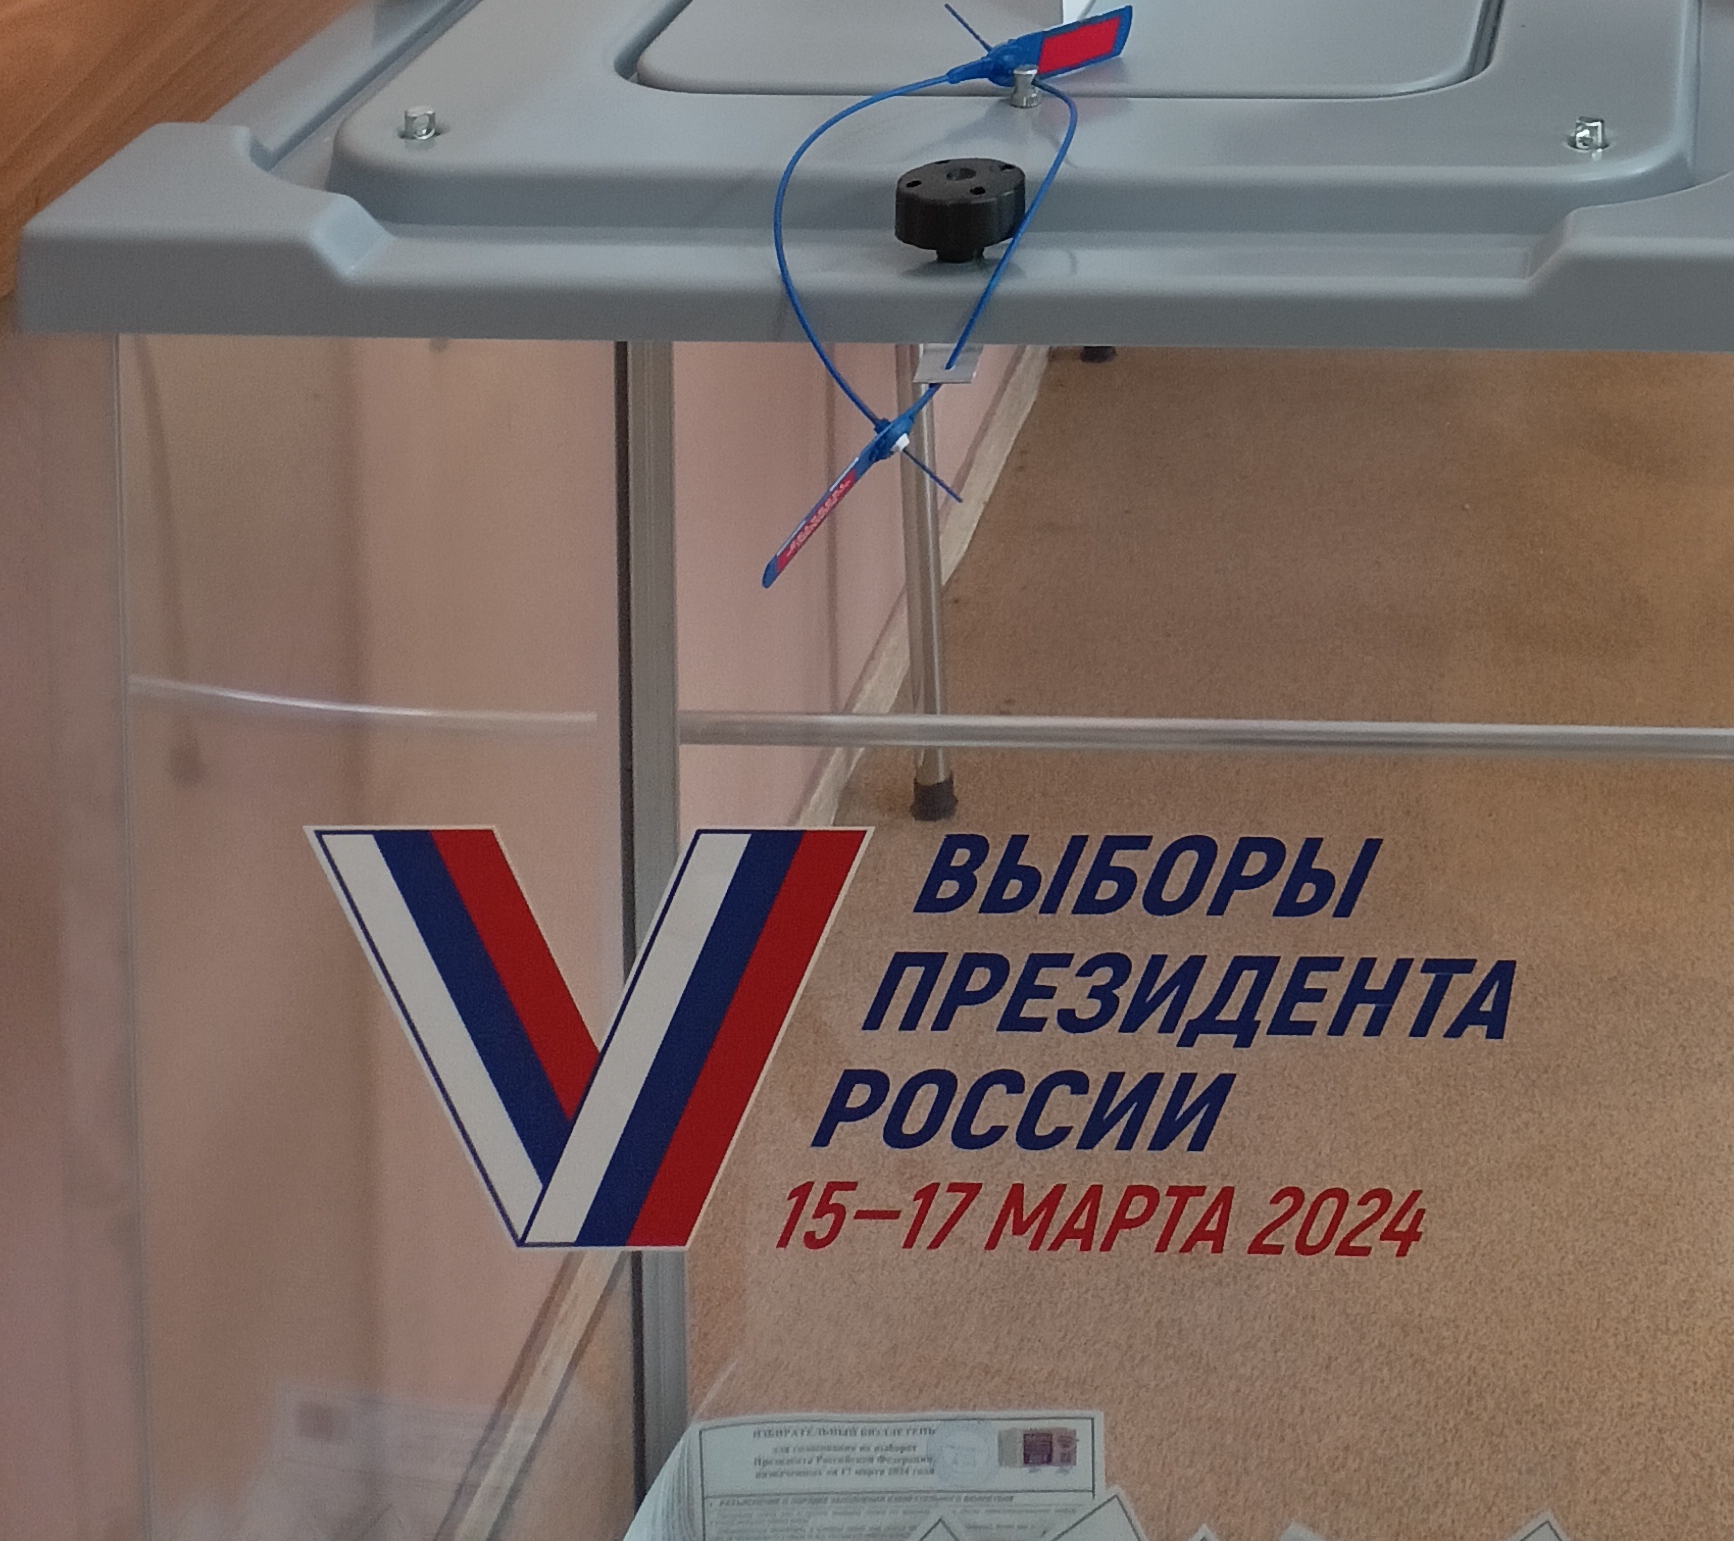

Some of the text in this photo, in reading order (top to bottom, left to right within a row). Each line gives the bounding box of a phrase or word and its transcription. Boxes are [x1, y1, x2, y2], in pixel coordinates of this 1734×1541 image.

[913, 833, 1382, 919] ВЫБОРЫ
[861, 951, 1518, 1048] ПРЕЗИДЕНТА
[812, 1069, 1237, 1152] РОССИИ
[984, 1183, 1236, 1253] МАРТА
[1247, 1186, 1427, 1258] 2024
